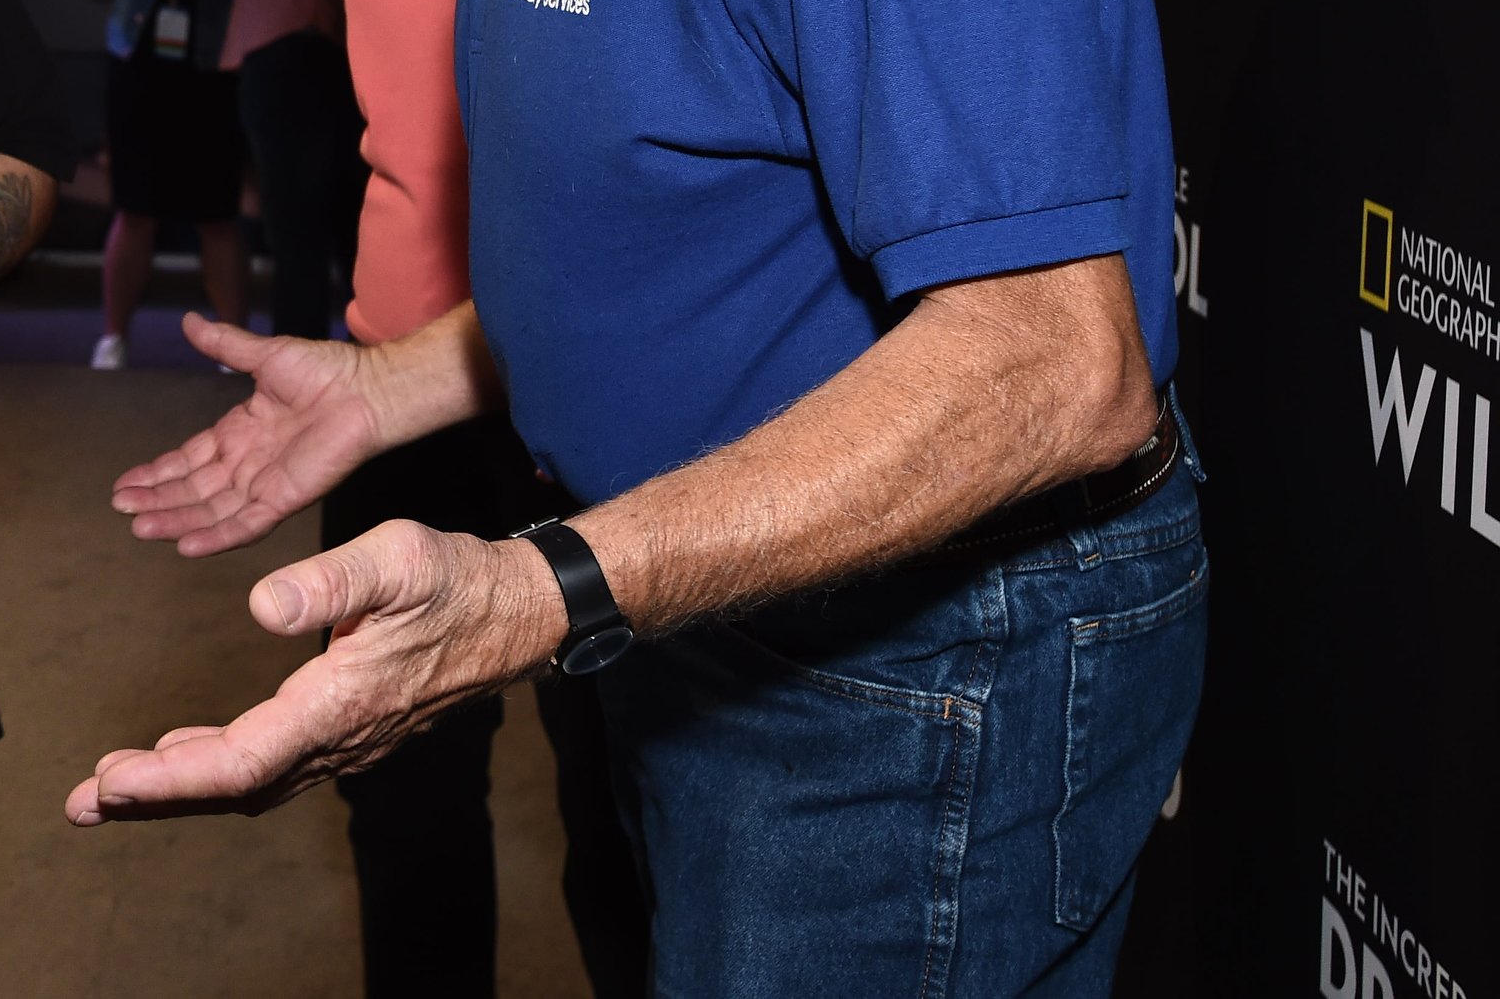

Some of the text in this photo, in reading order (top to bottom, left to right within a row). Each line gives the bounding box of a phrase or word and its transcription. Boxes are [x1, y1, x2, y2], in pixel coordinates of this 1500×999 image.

[1400, 226, 1495, 308] NATIONAL
[1360, 324, 1500, 549] WIL
[1323, 837, 1367, 923] THE
